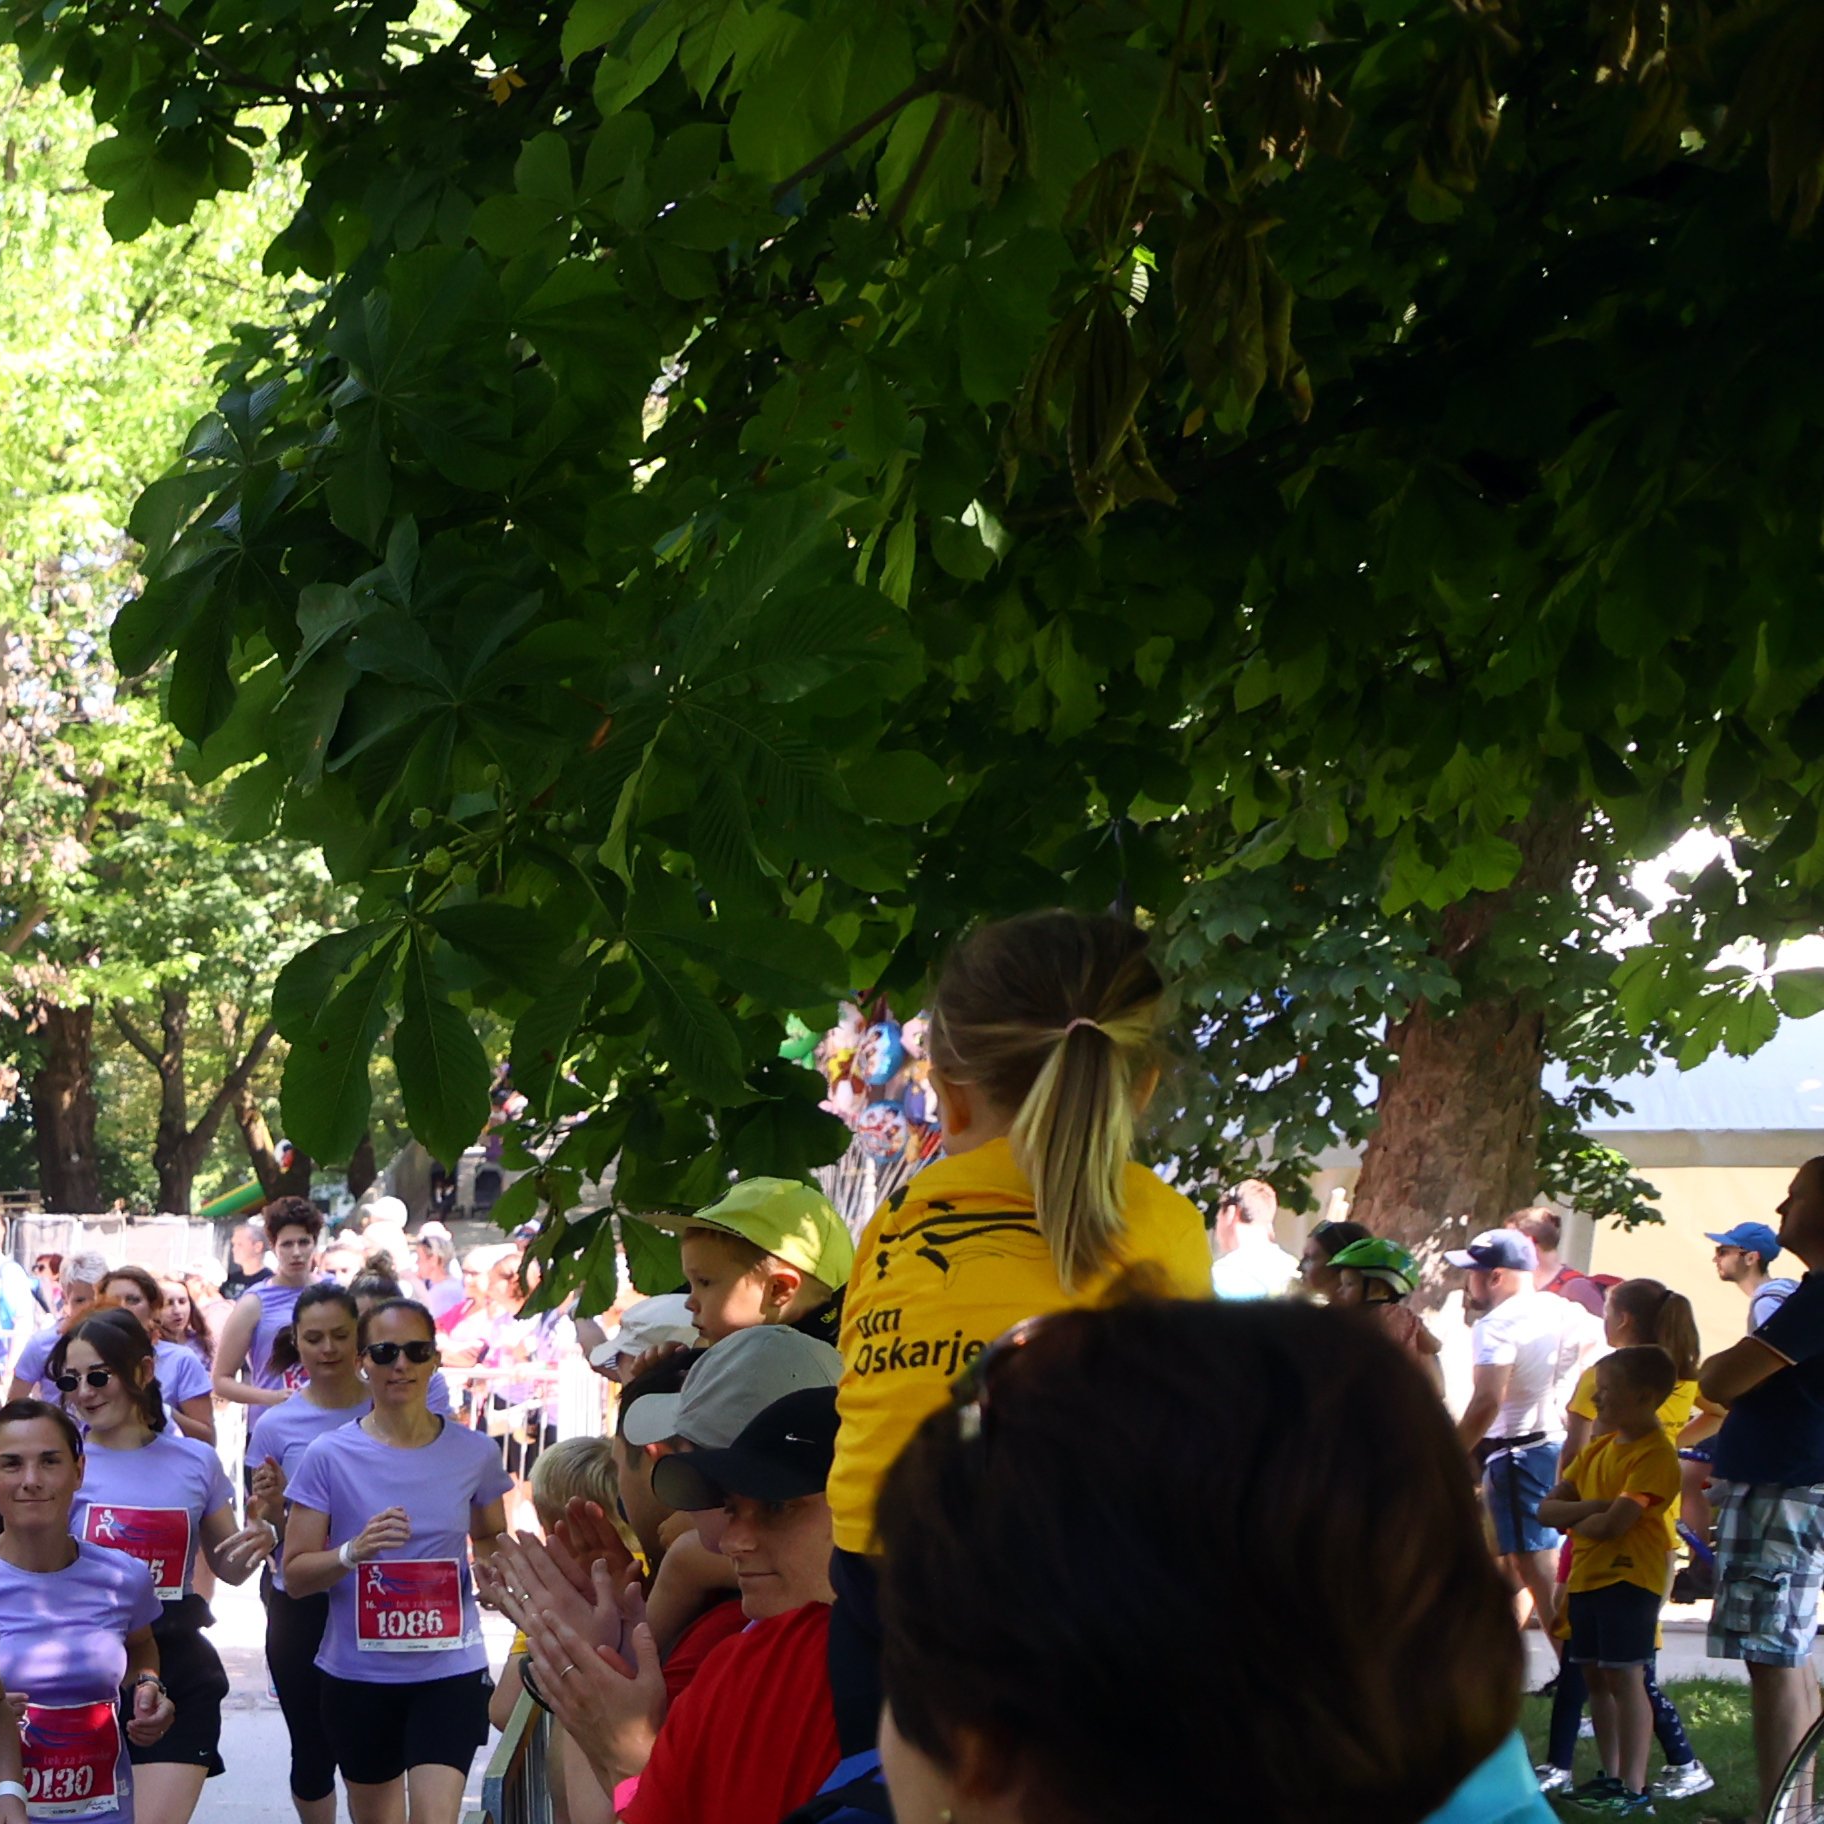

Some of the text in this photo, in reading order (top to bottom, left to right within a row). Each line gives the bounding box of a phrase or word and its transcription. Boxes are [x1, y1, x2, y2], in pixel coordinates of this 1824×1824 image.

[856, 1308, 902, 1339] dm
[377, 1609, 444, 1637] 1086
[23, 1765, 94, 1799] 0130
